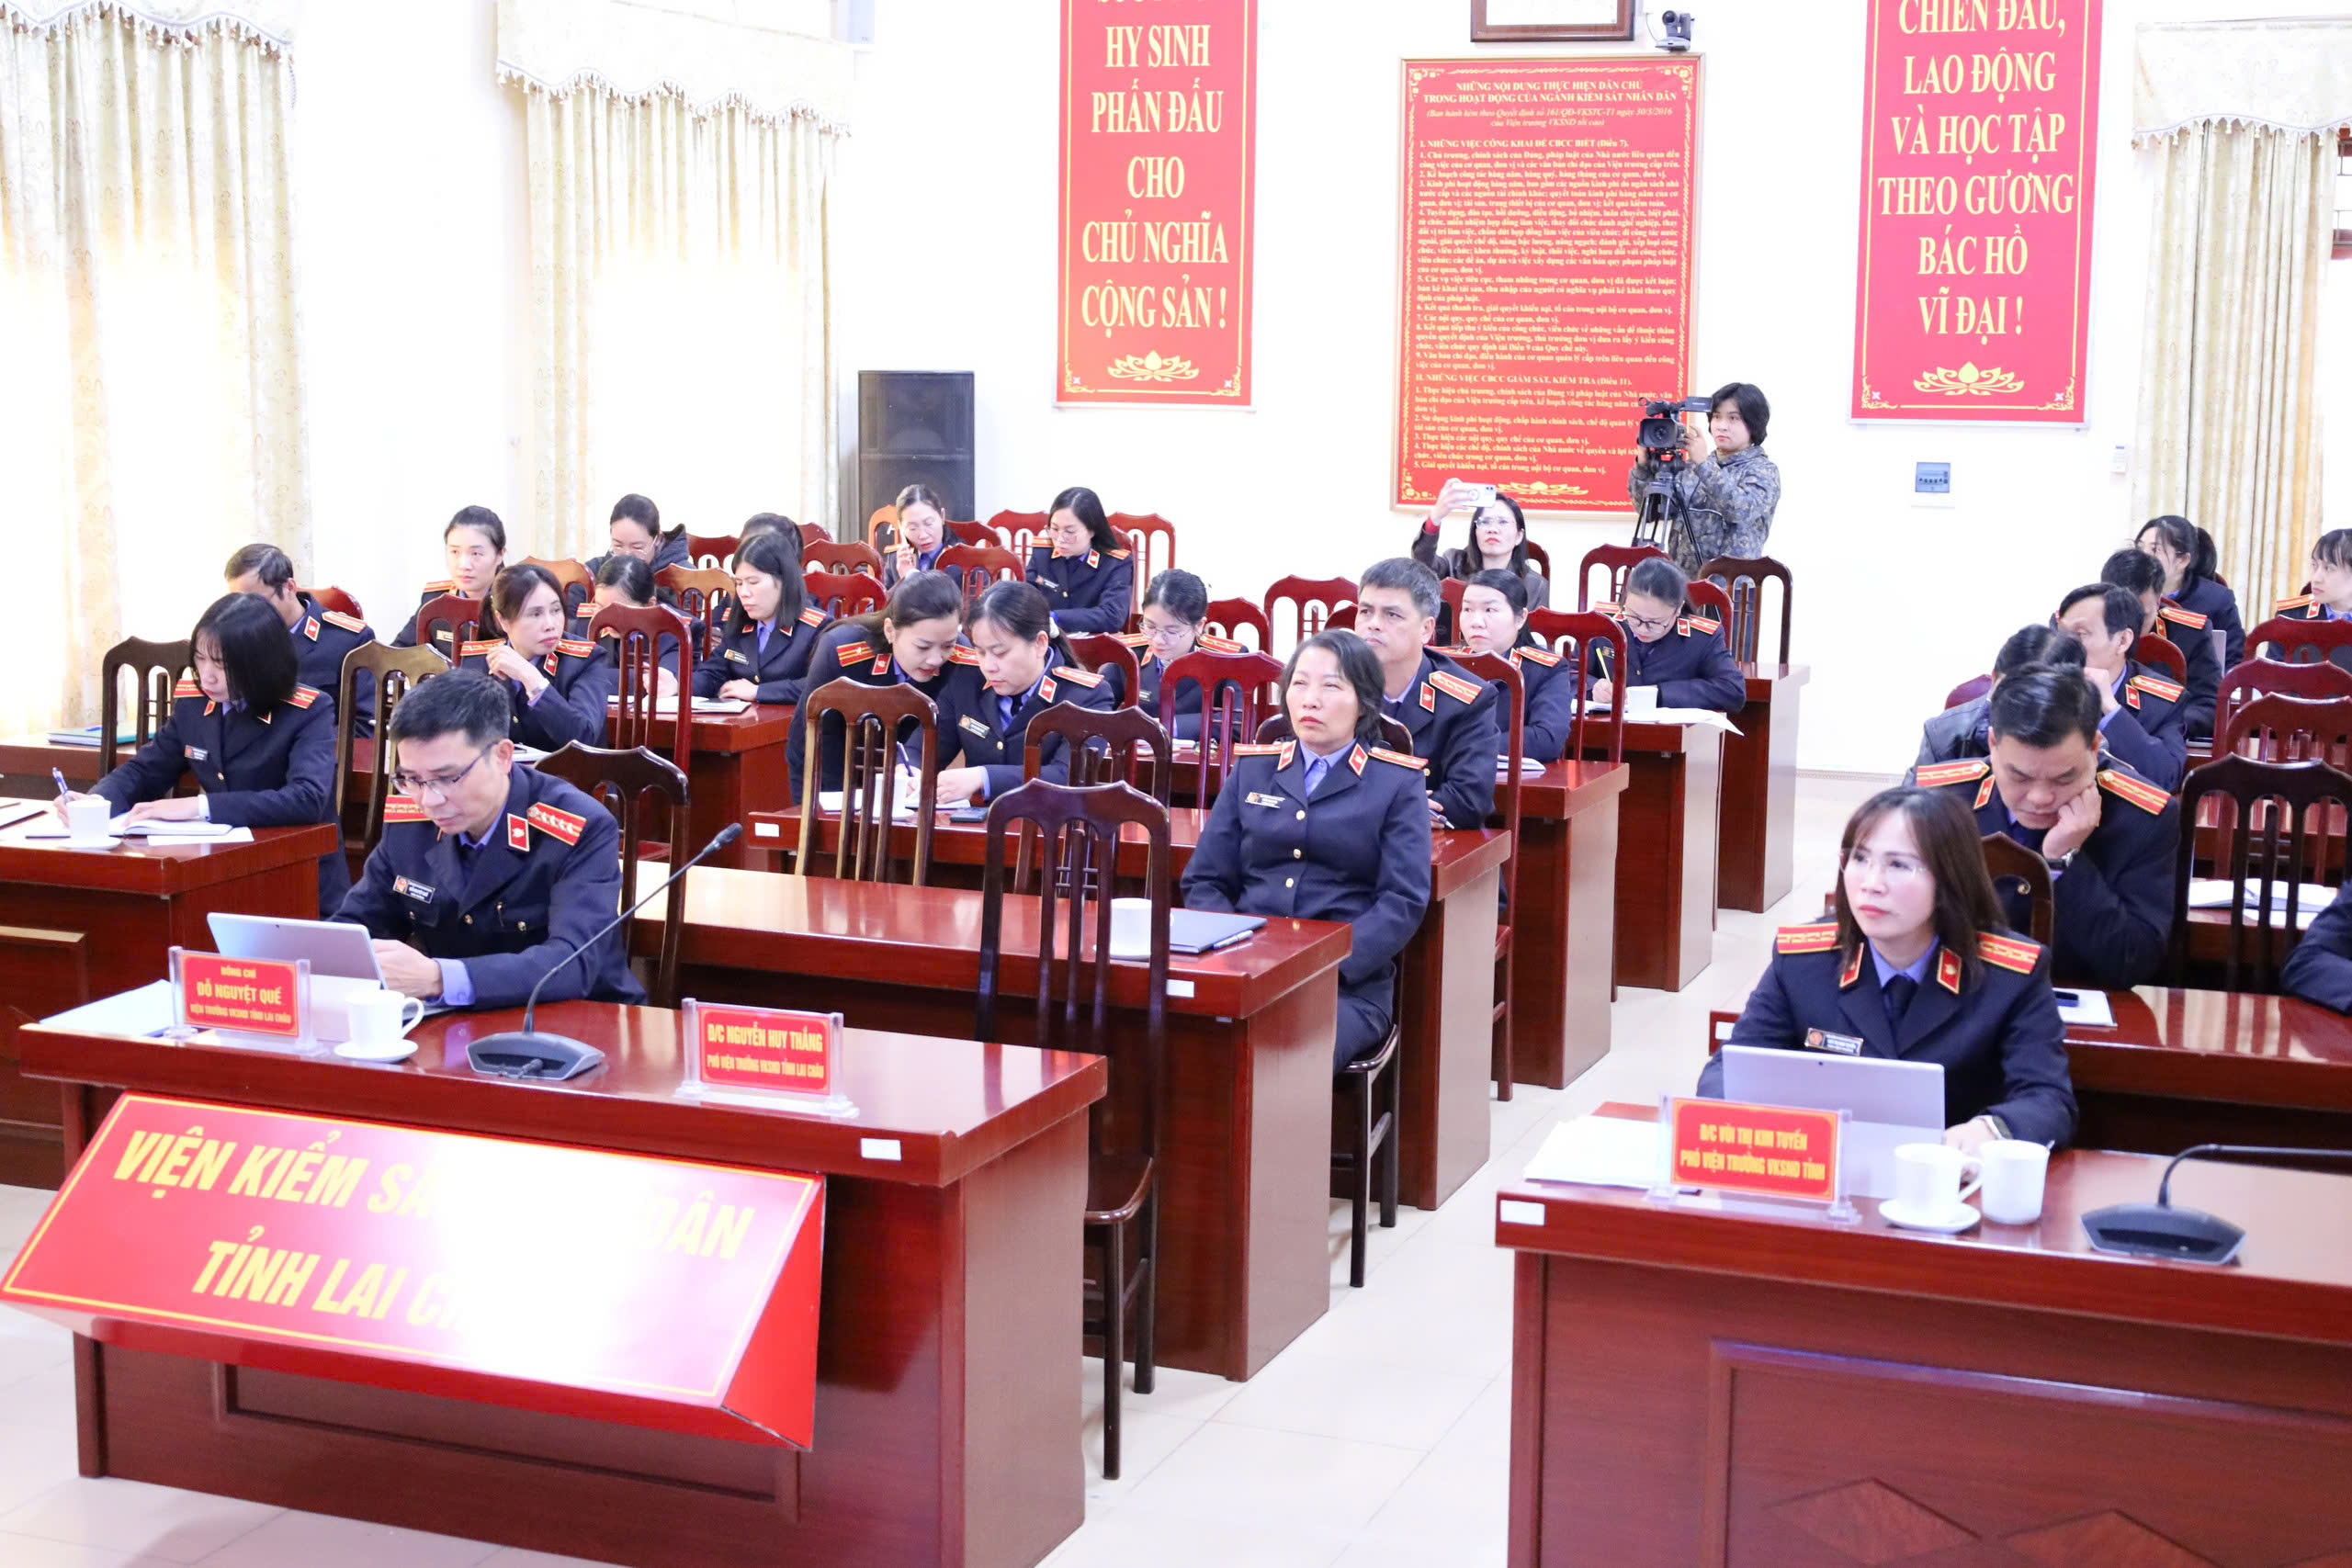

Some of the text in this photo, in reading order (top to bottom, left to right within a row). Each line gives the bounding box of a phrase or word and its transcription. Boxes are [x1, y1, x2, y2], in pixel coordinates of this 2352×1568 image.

[1105, 25, 1211, 68] HY SINH
[1904, 47, 2056, 103] LAO ĐỘNG
[1091, 77, 1223, 133] PHẤN ĐẤU
[1891, 105, 2065, 164] VÀ HỌC TẬP
[1127, 155, 1184, 198] CHO
[1878, 169, 2074, 215] THEO GƯƠNG
[1082, 209, 1229, 264] CHỦ NGHĨA
[1918, 224, 2028, 275] BÁC HỒ
[1081, 274, 1227, 338] CỘNG SẢN !
[1918, 286, 2024, 344] VĨ ĐẠI !
[707, 1021, 823, 1052] Đ/C NGUYỄN HUY THẮNG
[114, 1126, 238, 1199] VIỆN
[236, 1129, 370, 1209] KIỂM
[642, 1190, 756, 1259] DÂN
[193, 1225, 322, 1304] TỈNH
[311, 1255, 408, 1320] LAI
